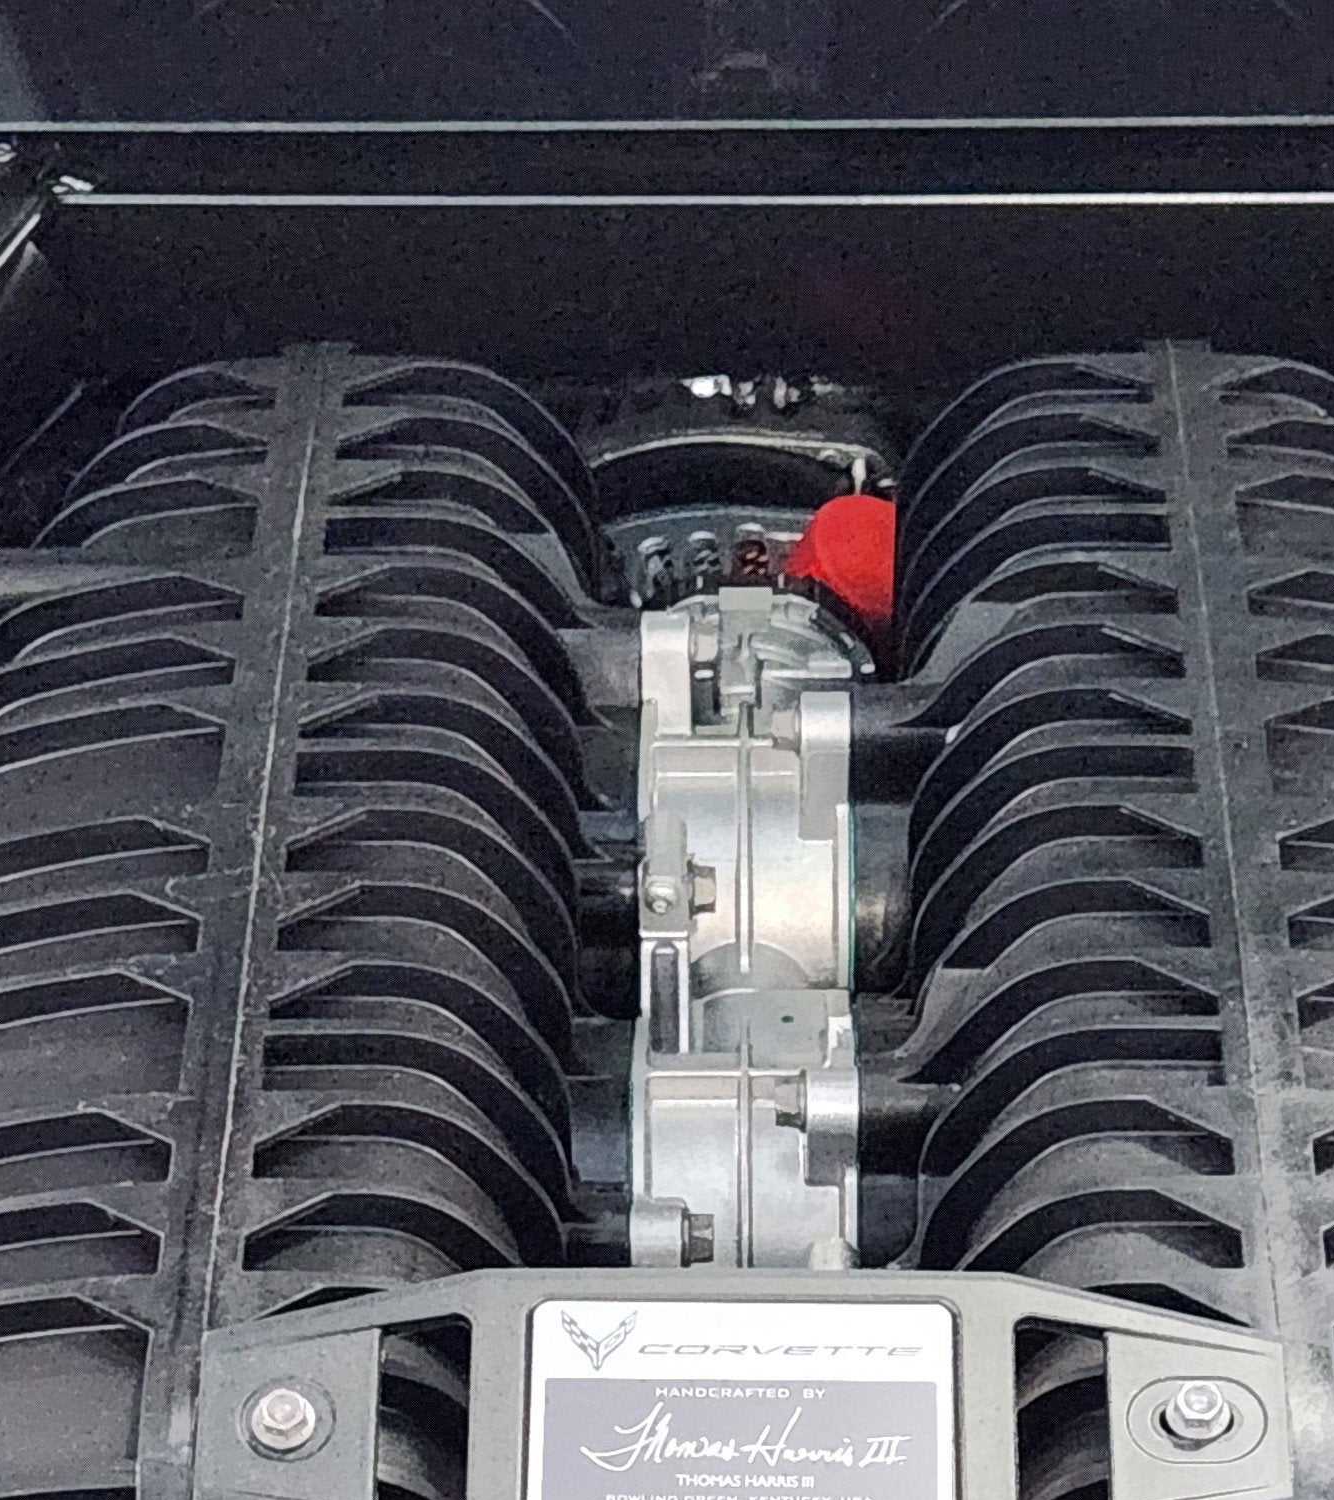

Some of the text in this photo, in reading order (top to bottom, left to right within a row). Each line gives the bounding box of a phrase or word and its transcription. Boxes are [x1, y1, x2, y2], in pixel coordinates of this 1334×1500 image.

[638, 1343, 923, 1356] CORVETTE
[655, 1387, 826, 1399] HANDCRAFTED BY
[675, 1473, 741, 1488] THOMAS
[744, 1474, 799, 1489] HARRIS
